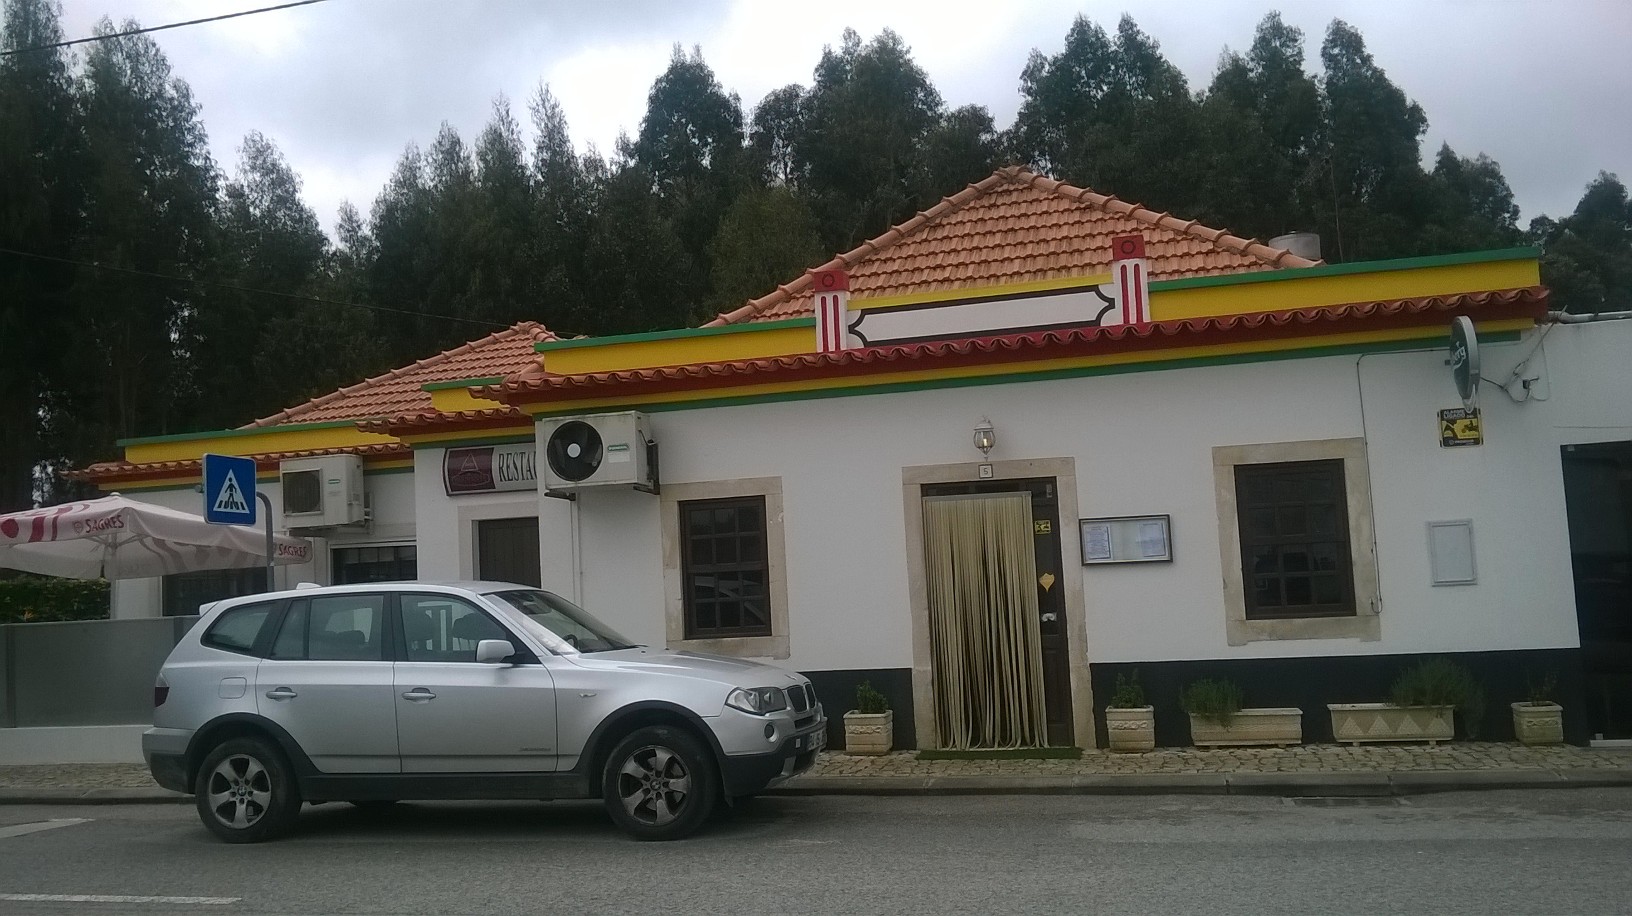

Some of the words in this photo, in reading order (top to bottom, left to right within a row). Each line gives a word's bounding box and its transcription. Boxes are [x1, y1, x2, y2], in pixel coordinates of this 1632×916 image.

[983, 467, 989, 475] 5
[85, 514, 125, 533] SAGRES
[278, 543, 308, 558] SAGRES
